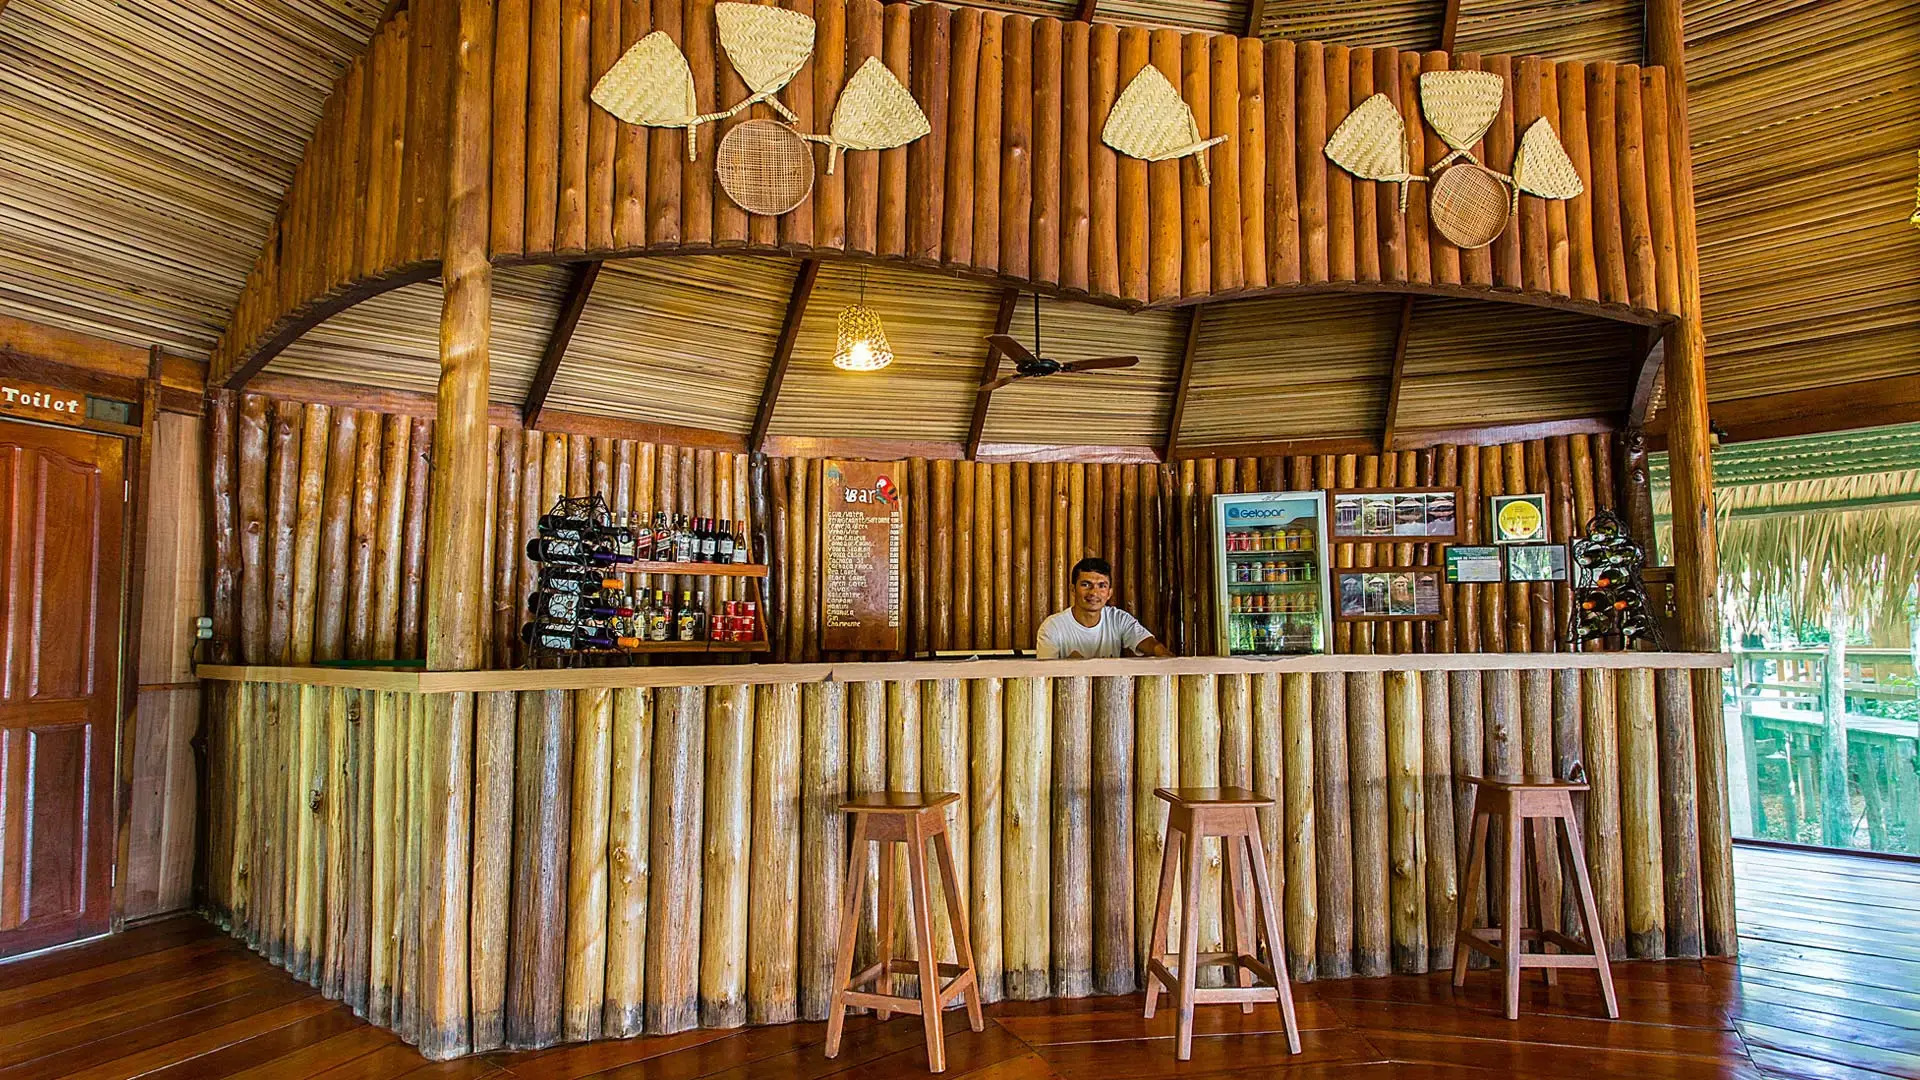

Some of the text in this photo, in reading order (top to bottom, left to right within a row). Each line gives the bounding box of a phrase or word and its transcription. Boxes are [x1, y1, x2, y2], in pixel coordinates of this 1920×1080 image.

[1, 386, 79, 413] Toilet
[845, 487, 876, 504] Bar
[1240, 509, 1285, 518] Gelopar
